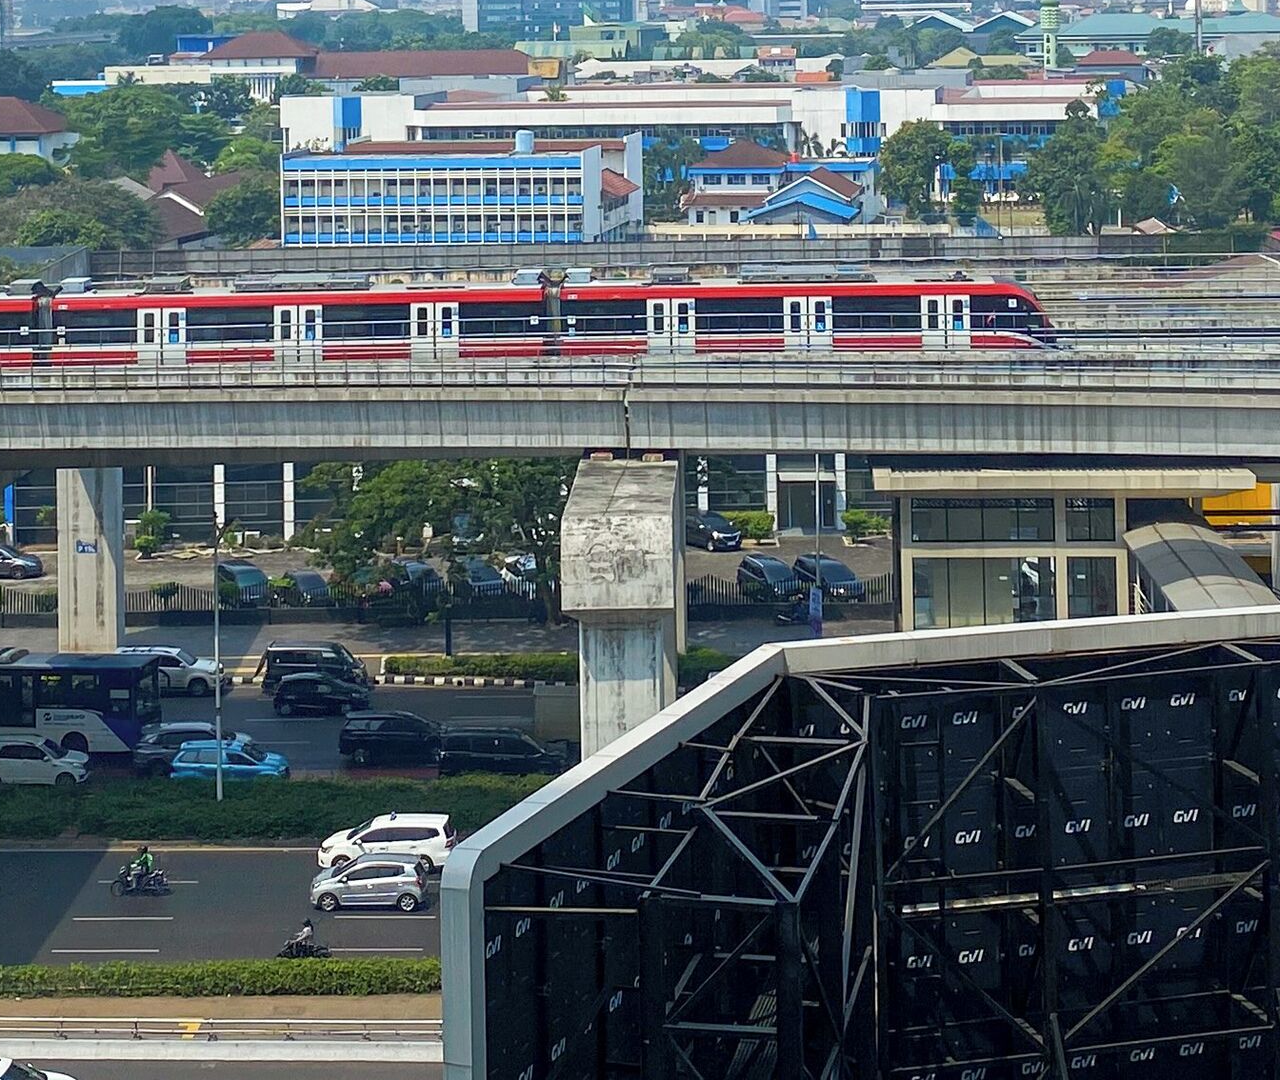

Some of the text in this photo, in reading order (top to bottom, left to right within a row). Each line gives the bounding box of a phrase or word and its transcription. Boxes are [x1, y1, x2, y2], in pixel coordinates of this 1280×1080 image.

[1121, 696, 1146, 710] GVI
[1170, 692, 1195, 706] GVI
[1228, 690, 1246, 702] GV
[1063, 702, 1088, 714] GVI
[900, 715, 927, 729] GVI
[952, 711, 978, 724] GVI
[798, 724, 815, 736] VI
[1174, 809, 1198, 822] GVI
[1232, 804, 1256, 818] GVI
[1065, 819, 1091, 834] GVI
[1124, 814, 1149, 828] GVI
[955, 830, 981, 844] GVI
[1015, 824, 1036, 838] GV
[631, 832, 644, 853] GVI
[904, 836, 930, 850] GI
[607, 849, 621, 871] GVI
[516, 918, 531, 938] GVI
[1236, 919, 1258, 933] GVI
[1068, 937, 1094, 952] GVI
[1127, 930, 1152, 945] GVI
[486, 935, 502, 960] GVI
[1018, 944, 1036, 957] GV
[906, 954, 932, 968] GVI
[958, 949, 984, 964] GVI
[610, 990, 623, 1013] GVI
[552, 1037, 566, 1062] GVI
[1179, 1042, 1204, 1056] GVI
[1239, 1036, 1262, 1050] GVI
[1130, 1048, 1155, 1062] GVI
[1071, 1055, 1096, 1070] GVI
